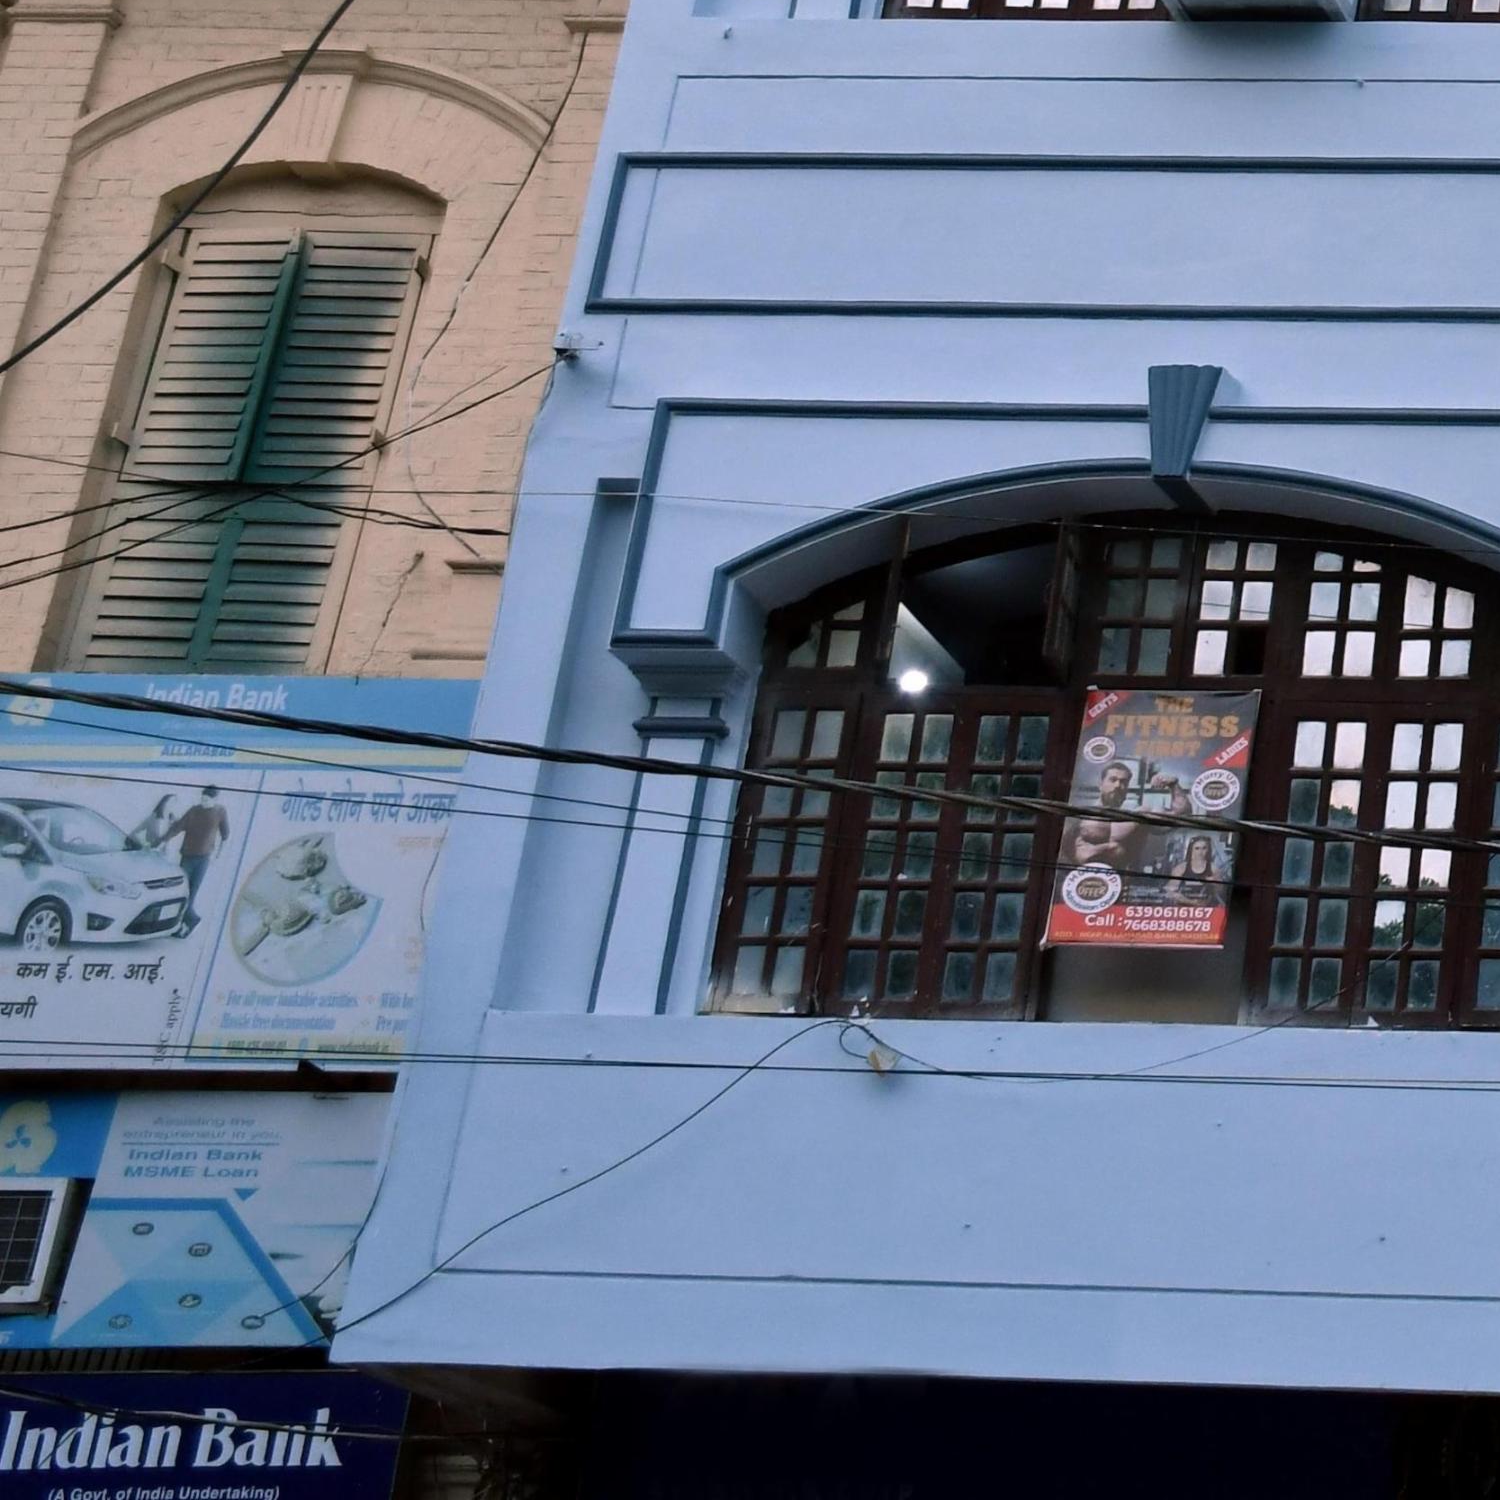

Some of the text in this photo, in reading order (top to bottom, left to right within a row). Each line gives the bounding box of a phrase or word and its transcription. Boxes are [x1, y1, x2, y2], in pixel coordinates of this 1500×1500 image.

[146, 683, 289, 710] Indian Bank
[1105, 714, 1240, 738] FITNESS
[1125, 906, 1213, 918] 6390616167
[1085, 914, 1114, 926] Call
[1124, 919, 1211, 932] 7668388678
[16, 962, 50, 979] कम
[82, 963, 115, 981] एम.
[123, 956, 165, 984] आई.
[230, 1117, 256, 1126] the
[123, 1130, 225, 1141] entrepreneur
[128, 1149, 262, 1161] Indian Bank
[123, 1165, 258, 1178] MSME Loan
[0, 1407, 343, 1470] Indian Bank
[115, 1487, 132, 1500] of
[136, 1487, 174, 1500] India
[179, 1486, 280, 1500] Undertaking)
